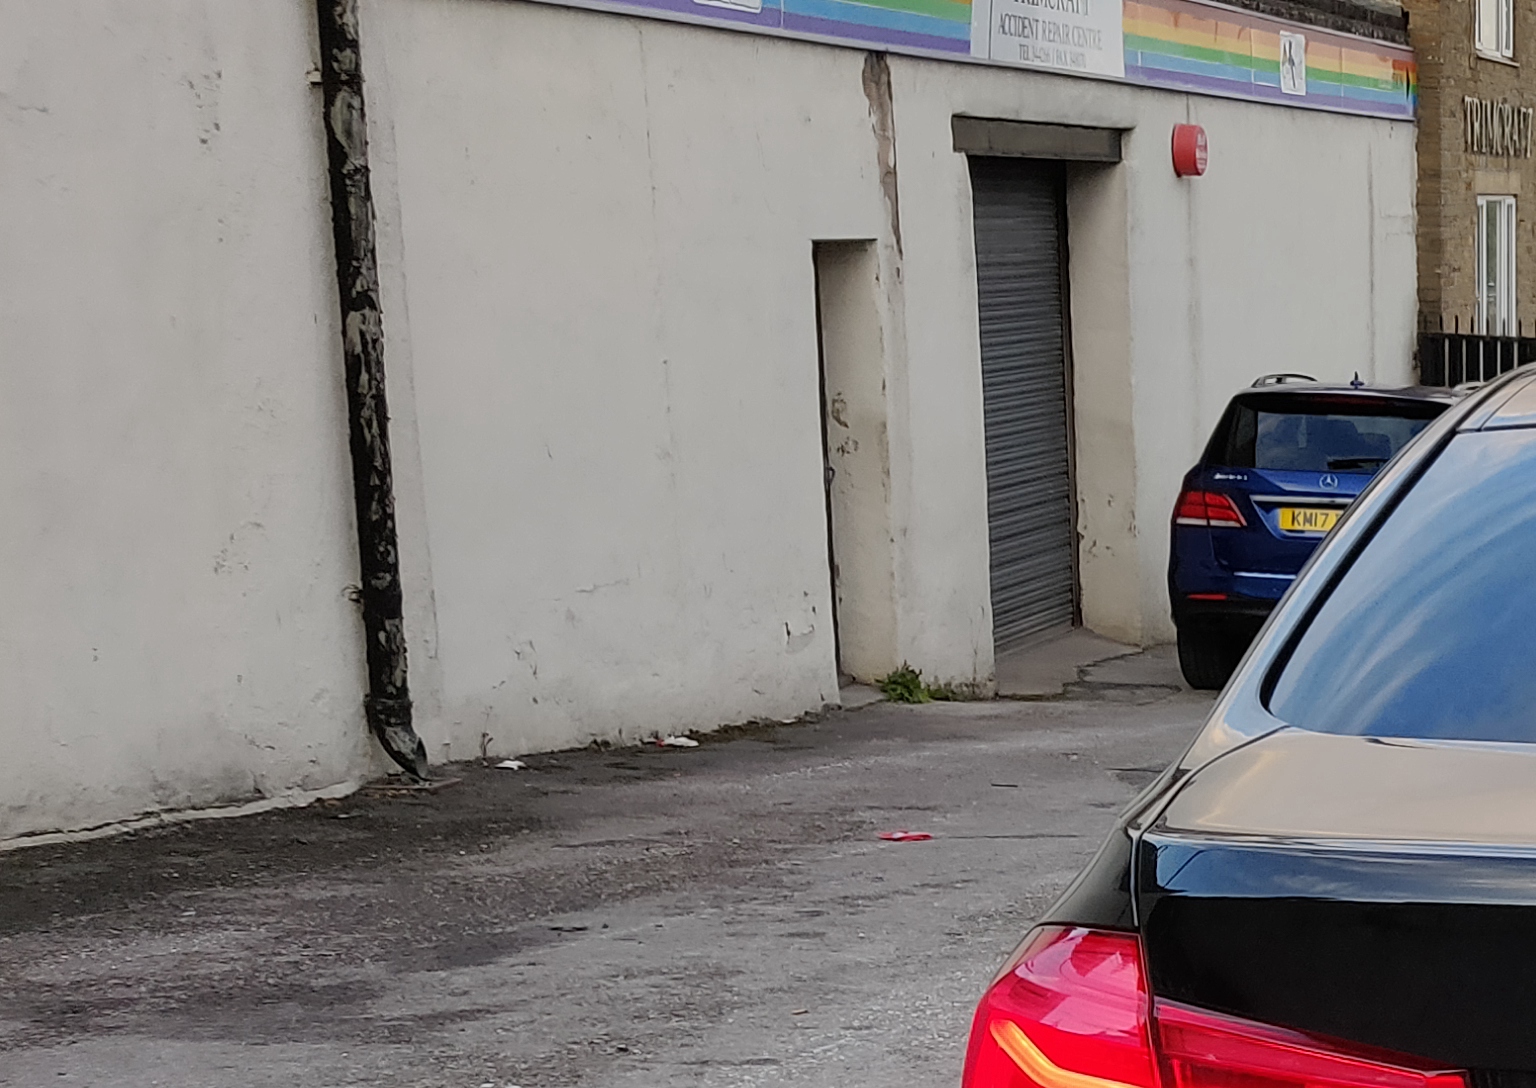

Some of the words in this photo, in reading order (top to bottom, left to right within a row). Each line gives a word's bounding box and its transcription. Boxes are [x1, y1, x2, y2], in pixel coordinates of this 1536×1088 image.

[998, 12, 1039, 41] ACCIDENT
[1041, 20, 1069, 46] REPAIR
[1072, 25, 1103, 51] CENTRE
[1291, 510, 1329, 528] KM17
